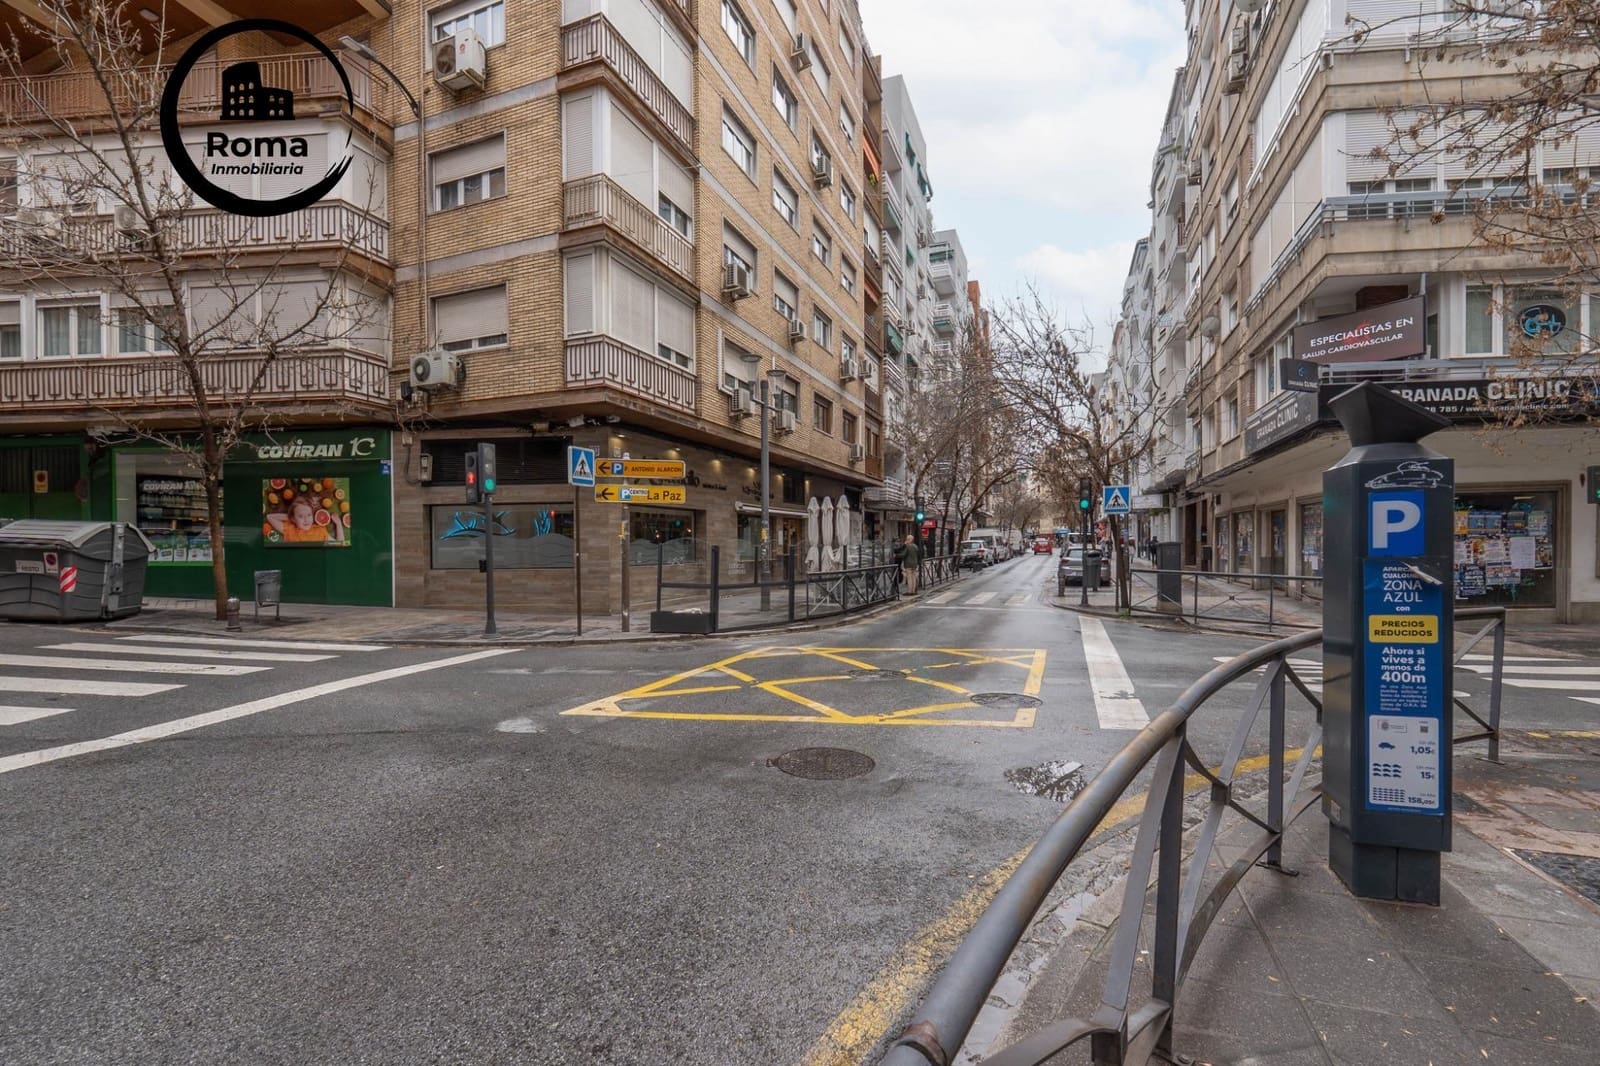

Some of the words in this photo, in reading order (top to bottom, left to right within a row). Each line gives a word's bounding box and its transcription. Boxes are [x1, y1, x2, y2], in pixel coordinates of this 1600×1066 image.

[1310, 321, 1392, 347] ESPECIALISTAS
[1395, 317, 1414, 329] EN
[1302, 349, 1326, 360] SALUD
[1327, 333, 1404, 354] CARDIOVASCULAR
[1486, 379, 1571, 400] CLINIC
[1440, 405, 1458, 413] 785
[647, 491, 660, 500] La
[663, 490, 682, 501] Paz
[1372, 500, 1421, 549] P
[1383, 580, 1423, 591] ZONA
[1383, 592, 1424, 602] AZUL
[1374, 629, 1433, 637] REDUCIDOS
[1382, 647, 1414, 655] Ahora
[1416, 647, 1425, 655] si
[1382, 655, 1414, 664] vives
[1417, 657, 1425, 665] a
[1381, 671, 1426, 683] 400m
